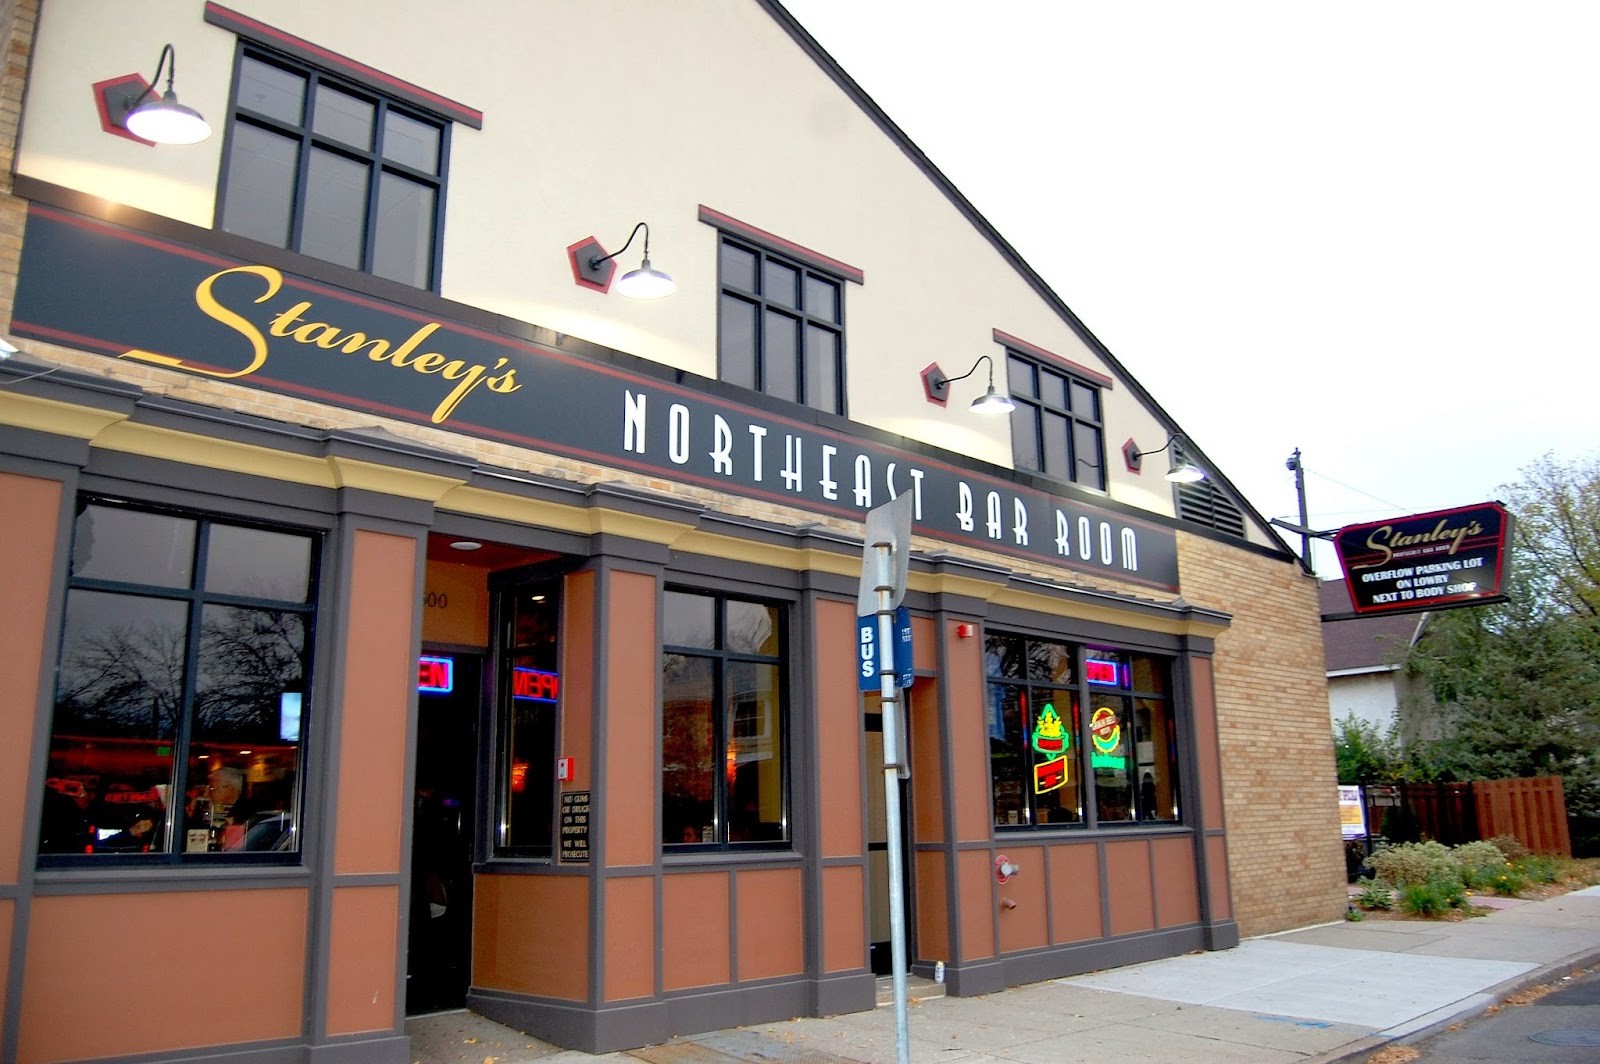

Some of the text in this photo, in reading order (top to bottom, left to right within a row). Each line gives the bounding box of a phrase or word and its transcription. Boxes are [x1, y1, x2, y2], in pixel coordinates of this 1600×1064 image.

[118, 265, 522, 424] Stanley's
[623, 389, 1138, 572] NORTHEAST BAR ROOM
[1351, 518, 1484, 570] Stanley's
[1361, 557, 1484, 583] OVERFLOW PARKING LOT
[1395, 574, 1450, 590] ON LOWRY
[1372, 581, 1477, 604] NEXT TO BODY SHOP
[861, 626, 875, 678] BUS
[418, 661, 449, 689] EN
